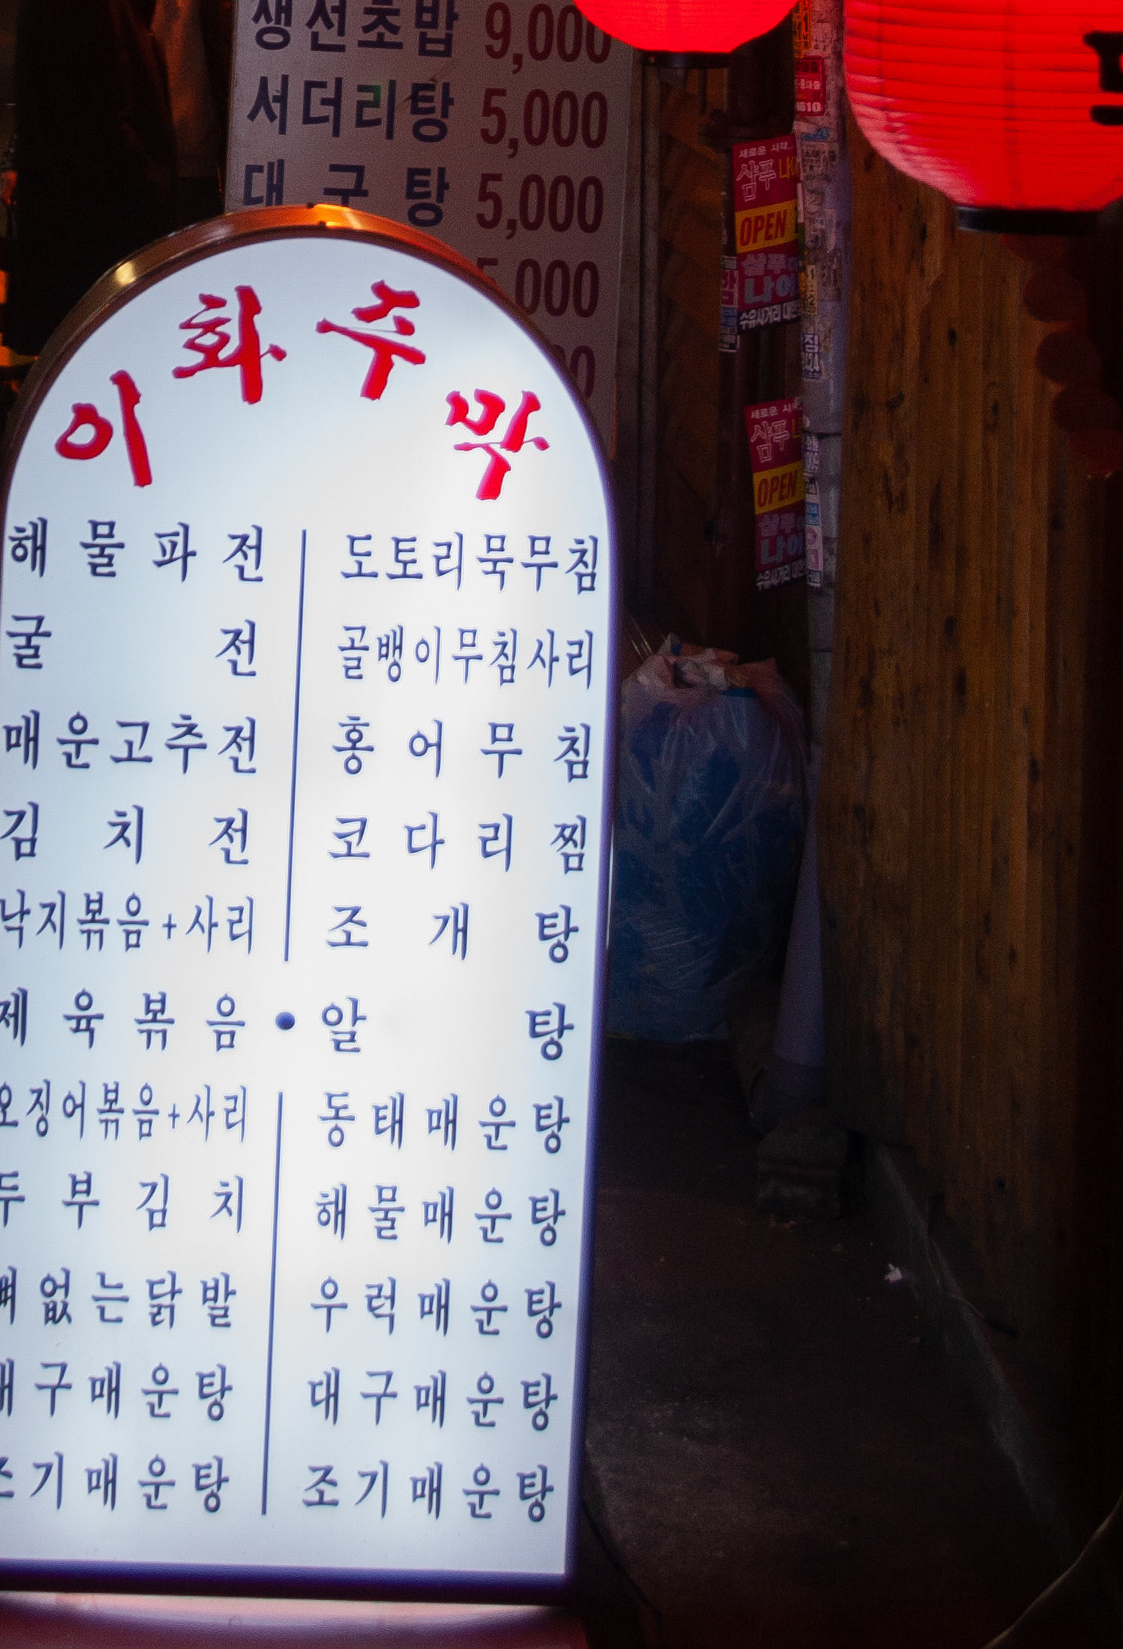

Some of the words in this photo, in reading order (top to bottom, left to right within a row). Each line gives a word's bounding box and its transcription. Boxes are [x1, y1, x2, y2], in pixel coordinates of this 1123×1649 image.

[484, 1, 611, 74] 9,000
[246, 73, 455, 143] 서더리탕
[479, 87, 608, 159] 5,000
[476, 172, 604, 240] 5,000
[740, 211, 787, 247] OPEN
[54, 280, 551, 502] 이화주막
[757, 471, 797, 507] OPEN
[341, 532, 598, 595] 도토리묵무침
[338, 625, 593, 690] 골뱅이무침사리
[2, 710, 256, 774] 매운고추전
[320, 1092, 570, 1156] 동태매운탕
[316, 1184, 566, 1248] 해물매운탕
[311, 1278, 562, 1340] 우럭매운탕
[310, 1368, 558, 1432] 대구매운탕
[303, 1462, 554, 1524] 조기매운탕
